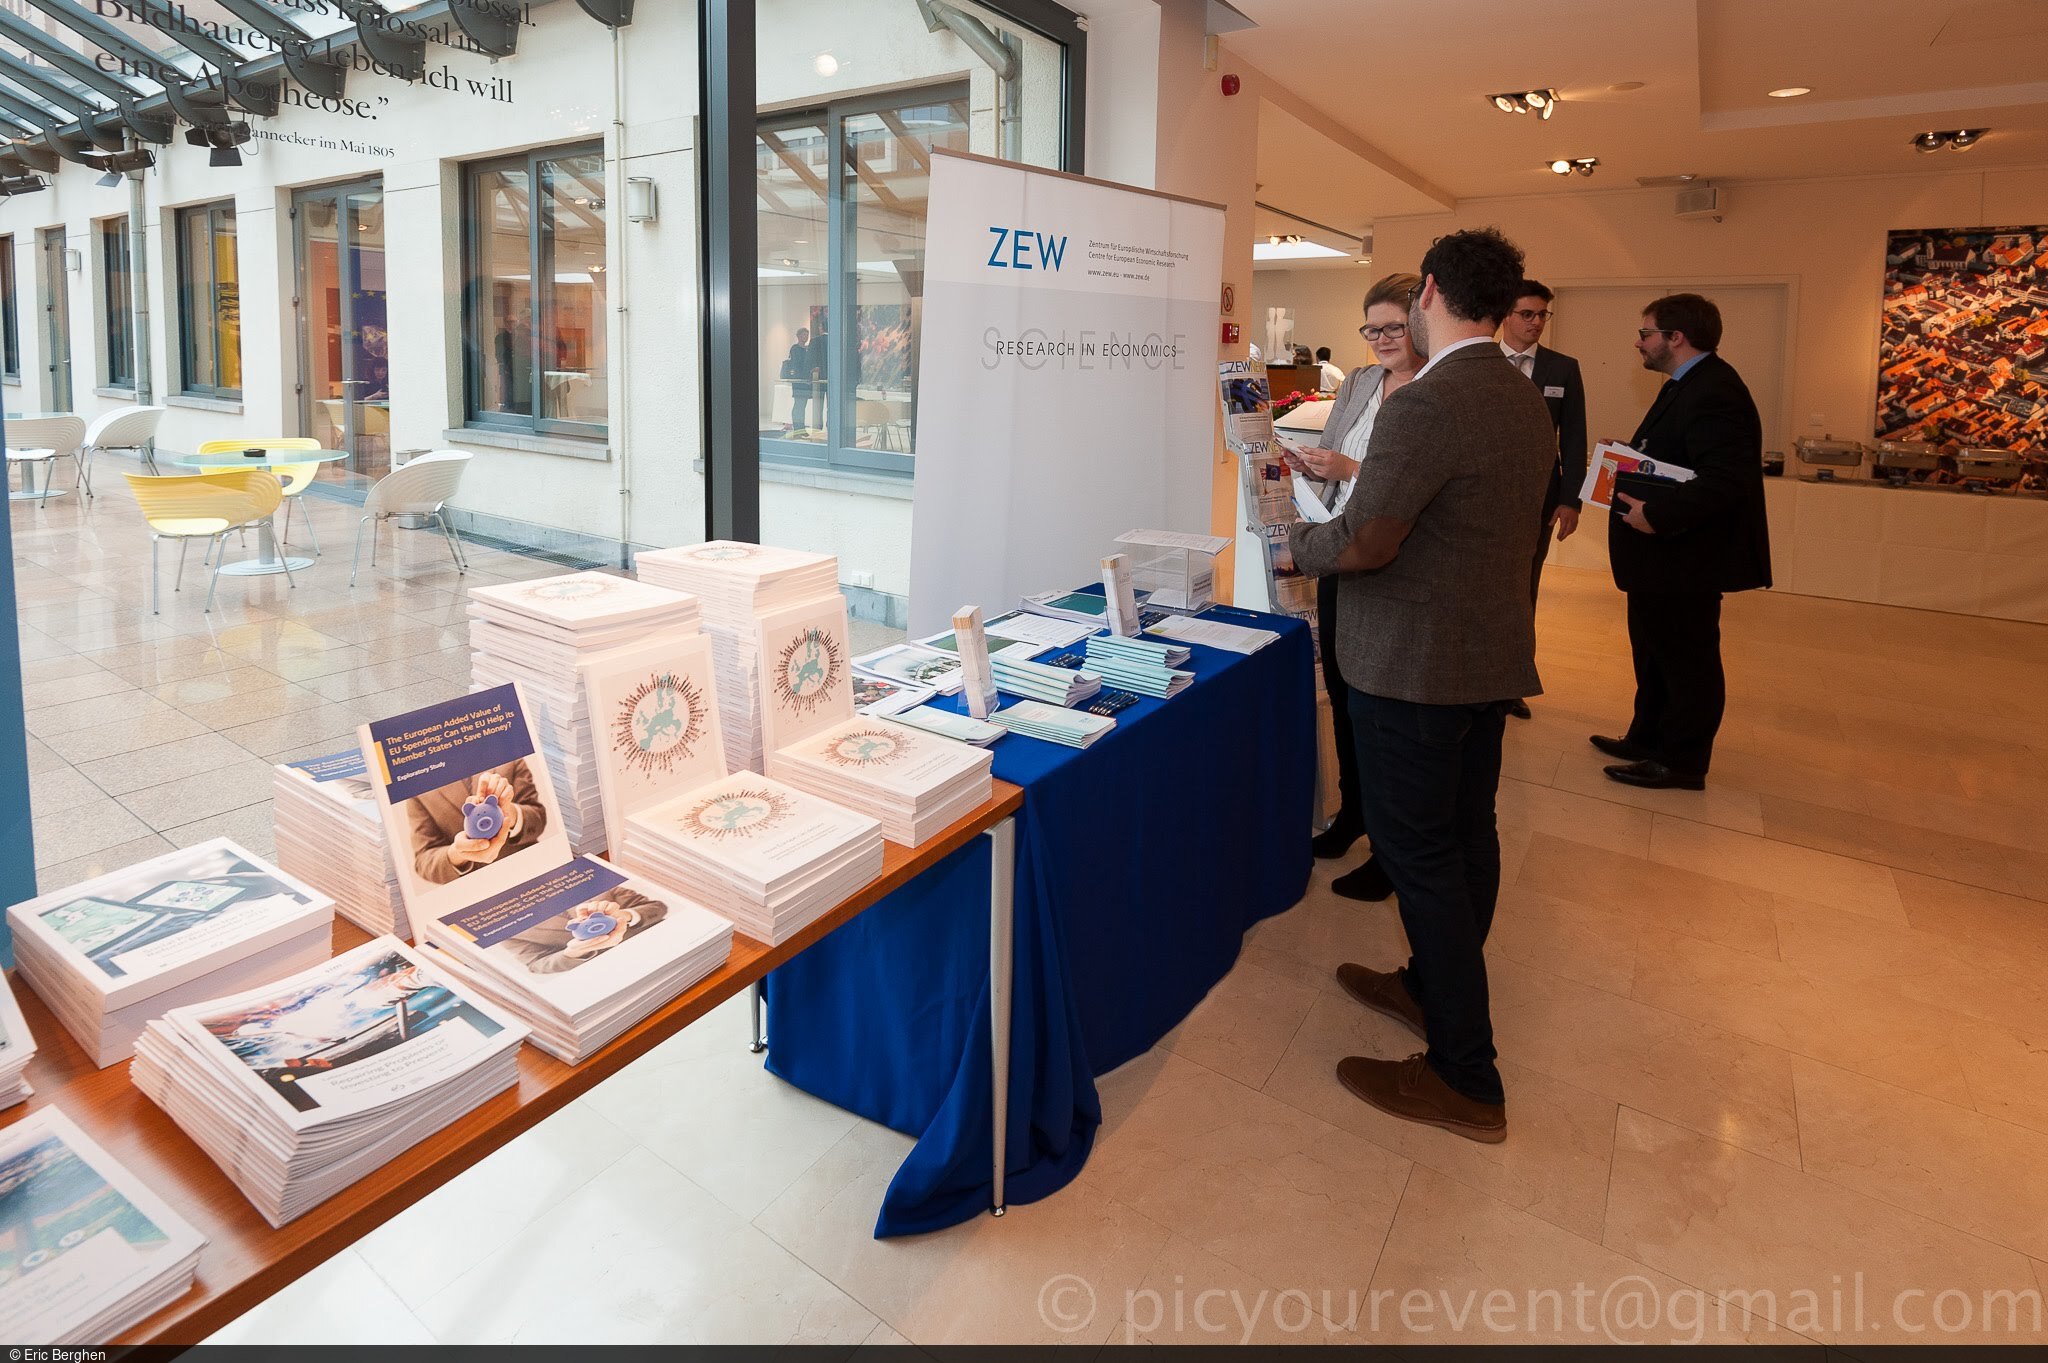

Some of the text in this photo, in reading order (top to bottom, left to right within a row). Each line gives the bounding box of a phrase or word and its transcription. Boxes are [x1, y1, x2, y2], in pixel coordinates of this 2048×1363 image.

[95, 46, 177, 83] eine
[324, 39, 412, 86] leben,
[420, 61, 459, 92] ich
[466, 77, 514, 103] will
[319, 136, 336, 150] im
[340, 140, 365, 154] Mai
[368, 145, 395, 159] 1805
[987, 227, 1068, 272] ZEW
[1088, 240, 1110, 249] Zentrum
[1110, 242, 1118, 250] für
[1088, 251, 1106, 260] Centre
[1113, 254, 1136, 264] European
[1136, 257, 1156, 266] Economic
[1156, 259, 1175, 268] Research
[1087, 269, 1119, 278] www.zew.eu
[981, 326, 1186, 371] SCIENCE
[996, 340, 1177, 358] RESEARCH IN ECONOMICS
[386, 703, 501, 745] The European Added Value of
[389, 710, 515, 756] EU Spending: Can the EU Help its
[392, 721, 512, 766] Member States to Save Money?
[396, 761, 446, 782] Exploratory Study
[460, 915, 478, 923] The
[479, 897, 519, 917] European
[520, 885, 546, 899] Added
[545, 875, 569, 887] Value
[472, 913, 508, 931] Member
[510, 901, 536, 916] States
[545, 888, 565, 898] Save
[523, 894, 539, 903] Can
[539, 887, 554, 896] the
[553, 881, 566, 889] EU
